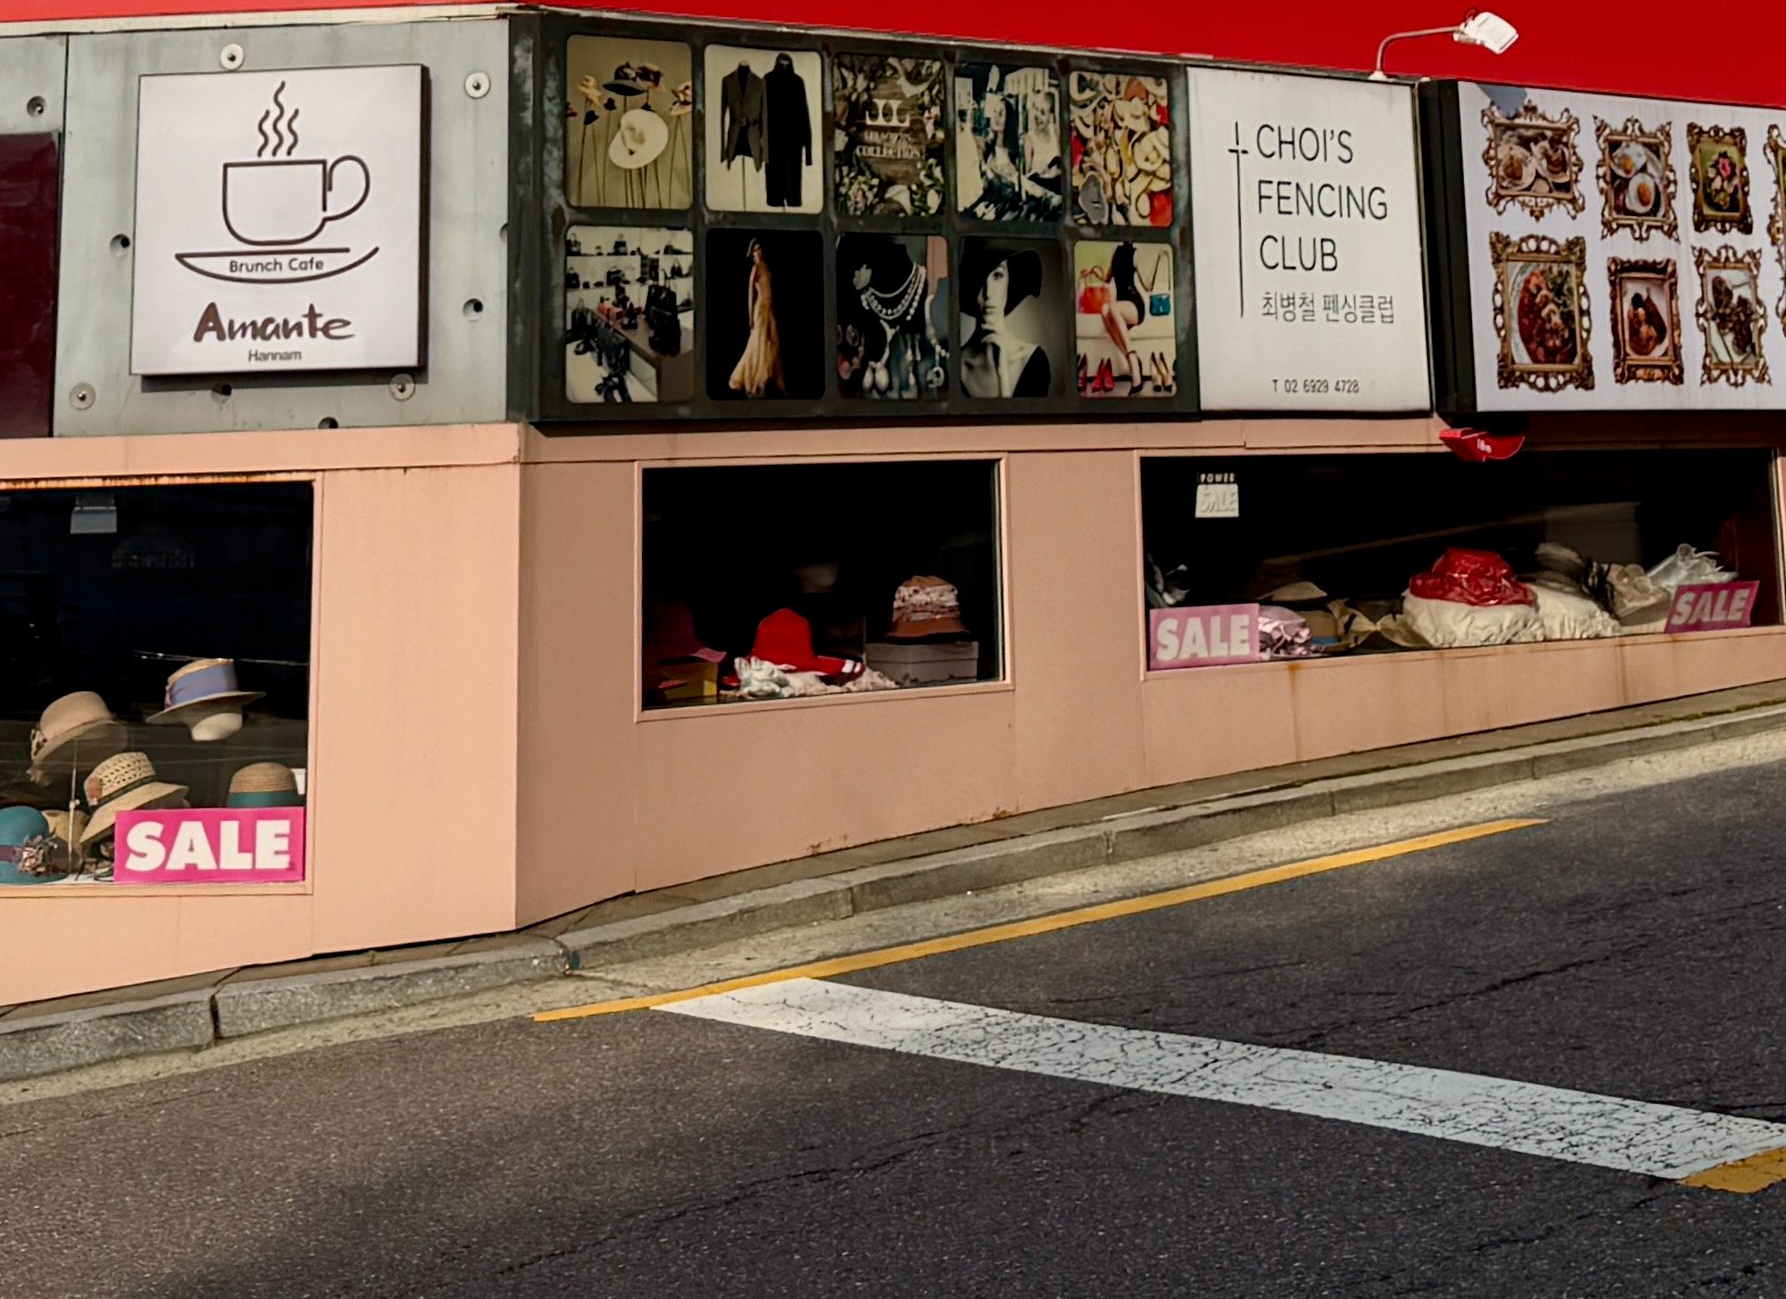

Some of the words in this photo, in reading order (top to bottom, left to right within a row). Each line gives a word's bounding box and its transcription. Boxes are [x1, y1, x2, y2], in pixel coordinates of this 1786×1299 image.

[1256, 124, 1354, 163] CHOI'S
[1258, 180, 1388, 220] FENCING
[229, 258, 283, 275] Brunch
[288, 256, 325, 273] Cafe
[1259, 235, 1338, 272] CLUB
[193, 302, 356, 344] Amante
[1261, 291, 1316, 322] 최병철
[1323, 293, 1395, 324] 펜싱클럽
[247, 349, 302, 363] Hannam
[1284, 379, 1298, 393] 02
[1671, 588, 1750, 626] SALE
[1156, 614, 1250, 661] SALE
[125, 819, 291, 871] SALE
